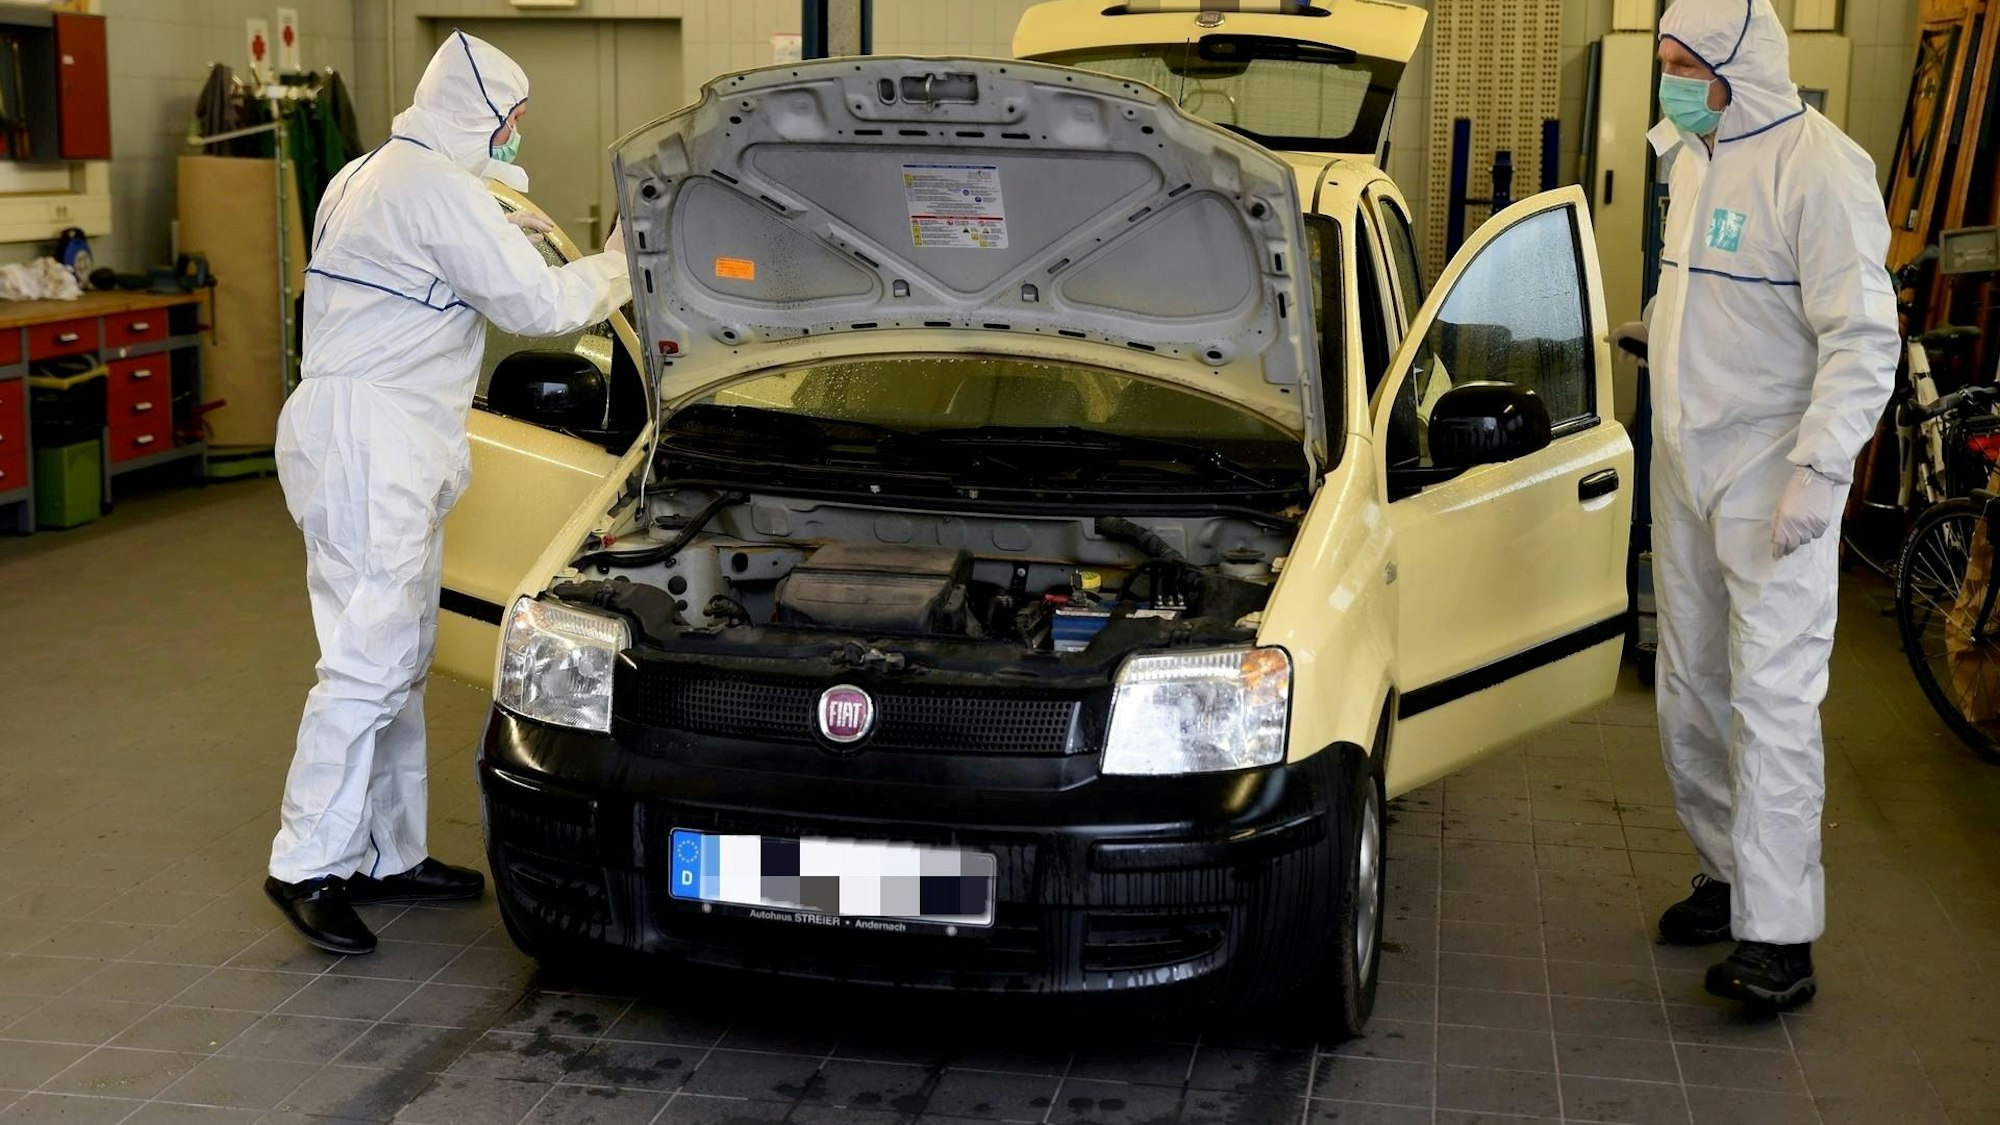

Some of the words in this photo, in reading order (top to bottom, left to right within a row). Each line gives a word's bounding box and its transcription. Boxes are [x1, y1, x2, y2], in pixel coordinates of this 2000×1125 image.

[829, 701, 862, 728] FIAT
[682, 870, 693, 885] D
[749, 909, 793, 921] Autohaus
[794, 912, 840, 926] STREIER
[855, 919, 906, 931] Andernach
